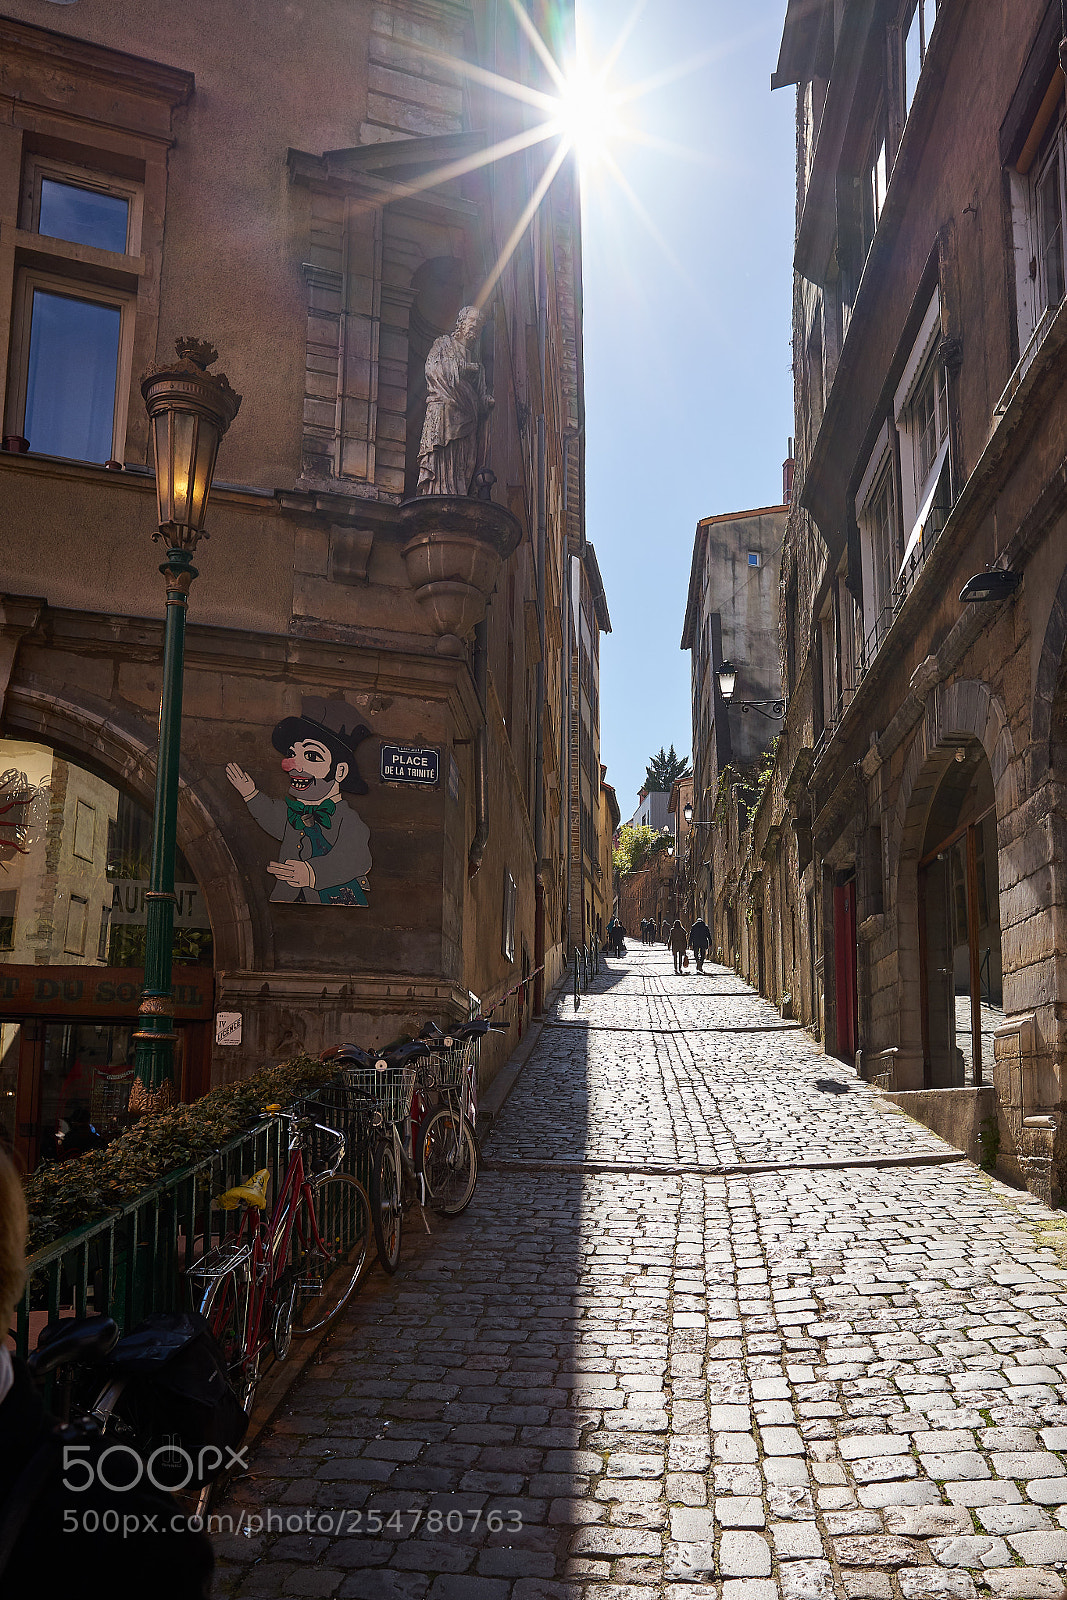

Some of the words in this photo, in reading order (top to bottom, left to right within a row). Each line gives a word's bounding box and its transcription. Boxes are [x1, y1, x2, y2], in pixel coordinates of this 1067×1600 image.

[385, 766, 394, 775] DE
[395, 766, 404, 776] LA
[407, 768, 435, 779] TRINITÉ
[392, 755, 428, 767] PLACE
[112, 885, 197, 917] AUNT
[33, 978, 84, 1001] DU
[95, 981, 203, 1006] SOIL
[217, 1017, 241, 1041] LICENCE
